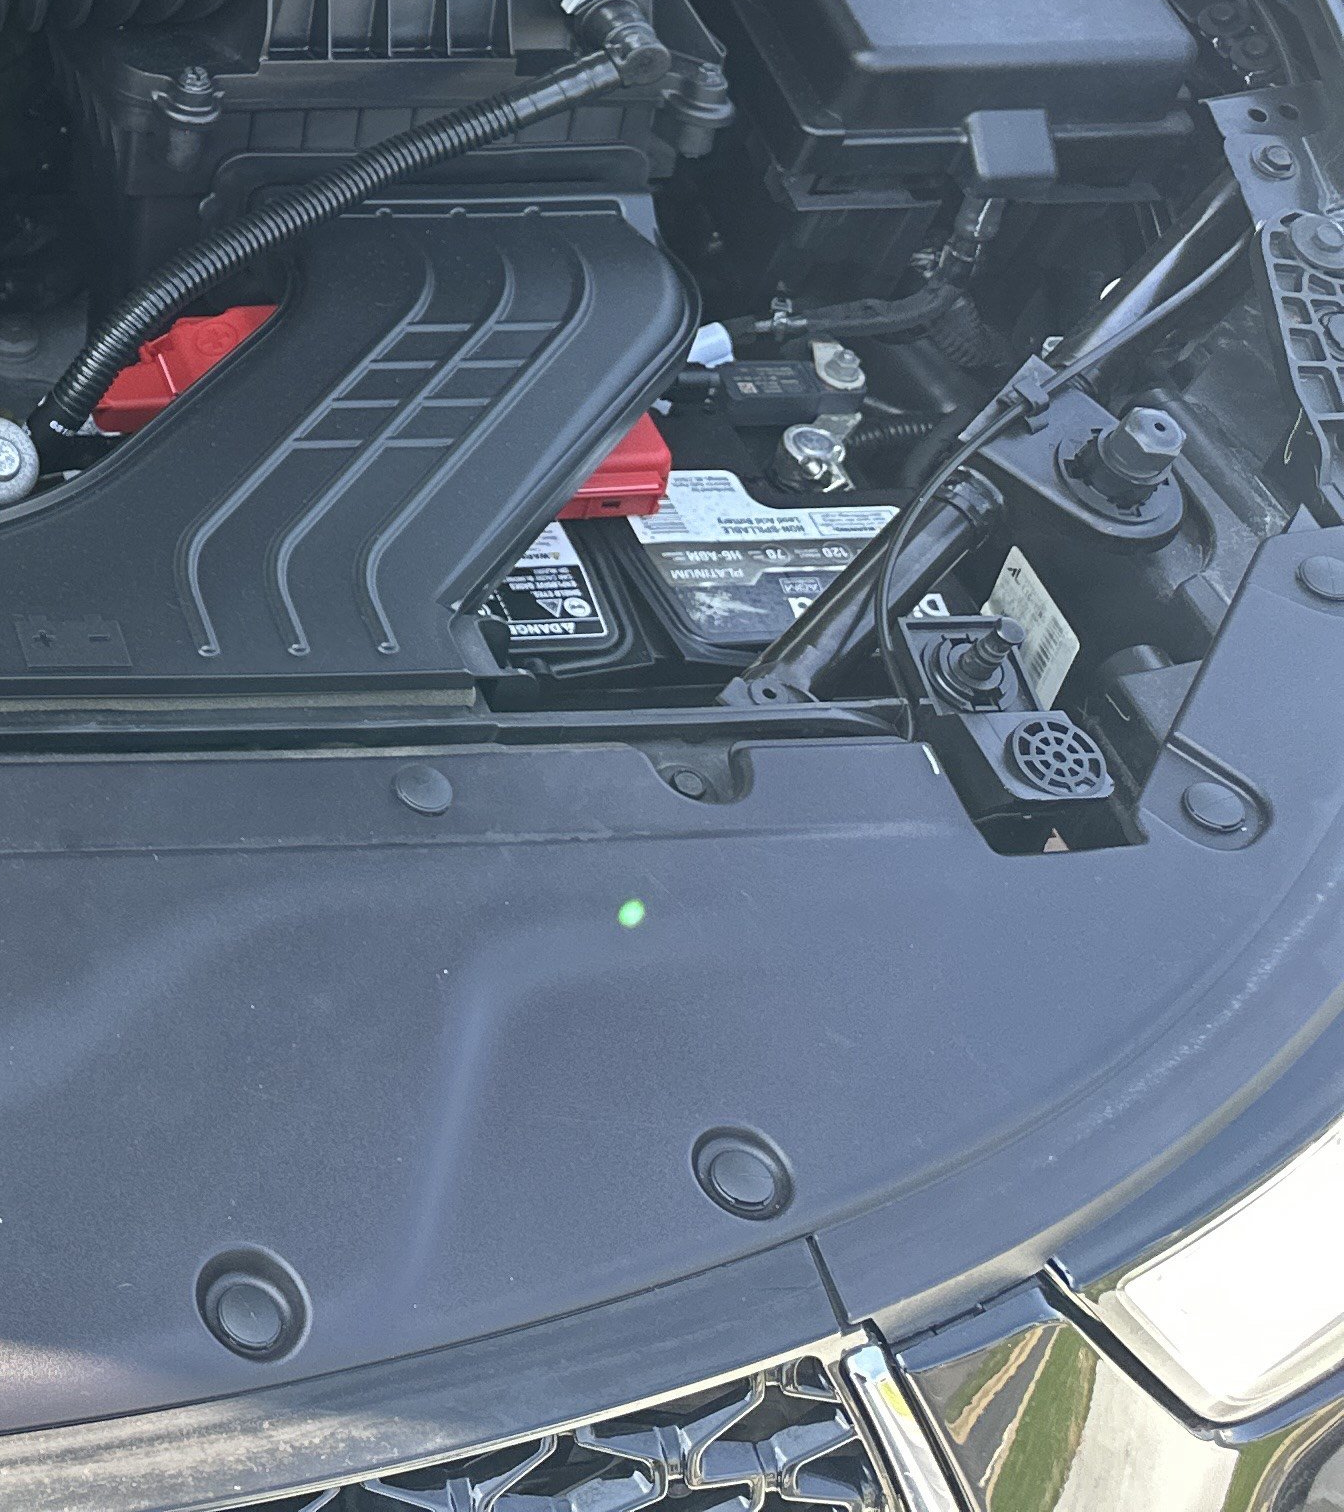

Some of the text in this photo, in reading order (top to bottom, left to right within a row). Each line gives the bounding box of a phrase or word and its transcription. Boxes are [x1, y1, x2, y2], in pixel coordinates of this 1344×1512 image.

[822, 546, 848, 559] 120
[670, 568, 744, 580] PLATINUM
[508, 622, 563, 635] DANGE
